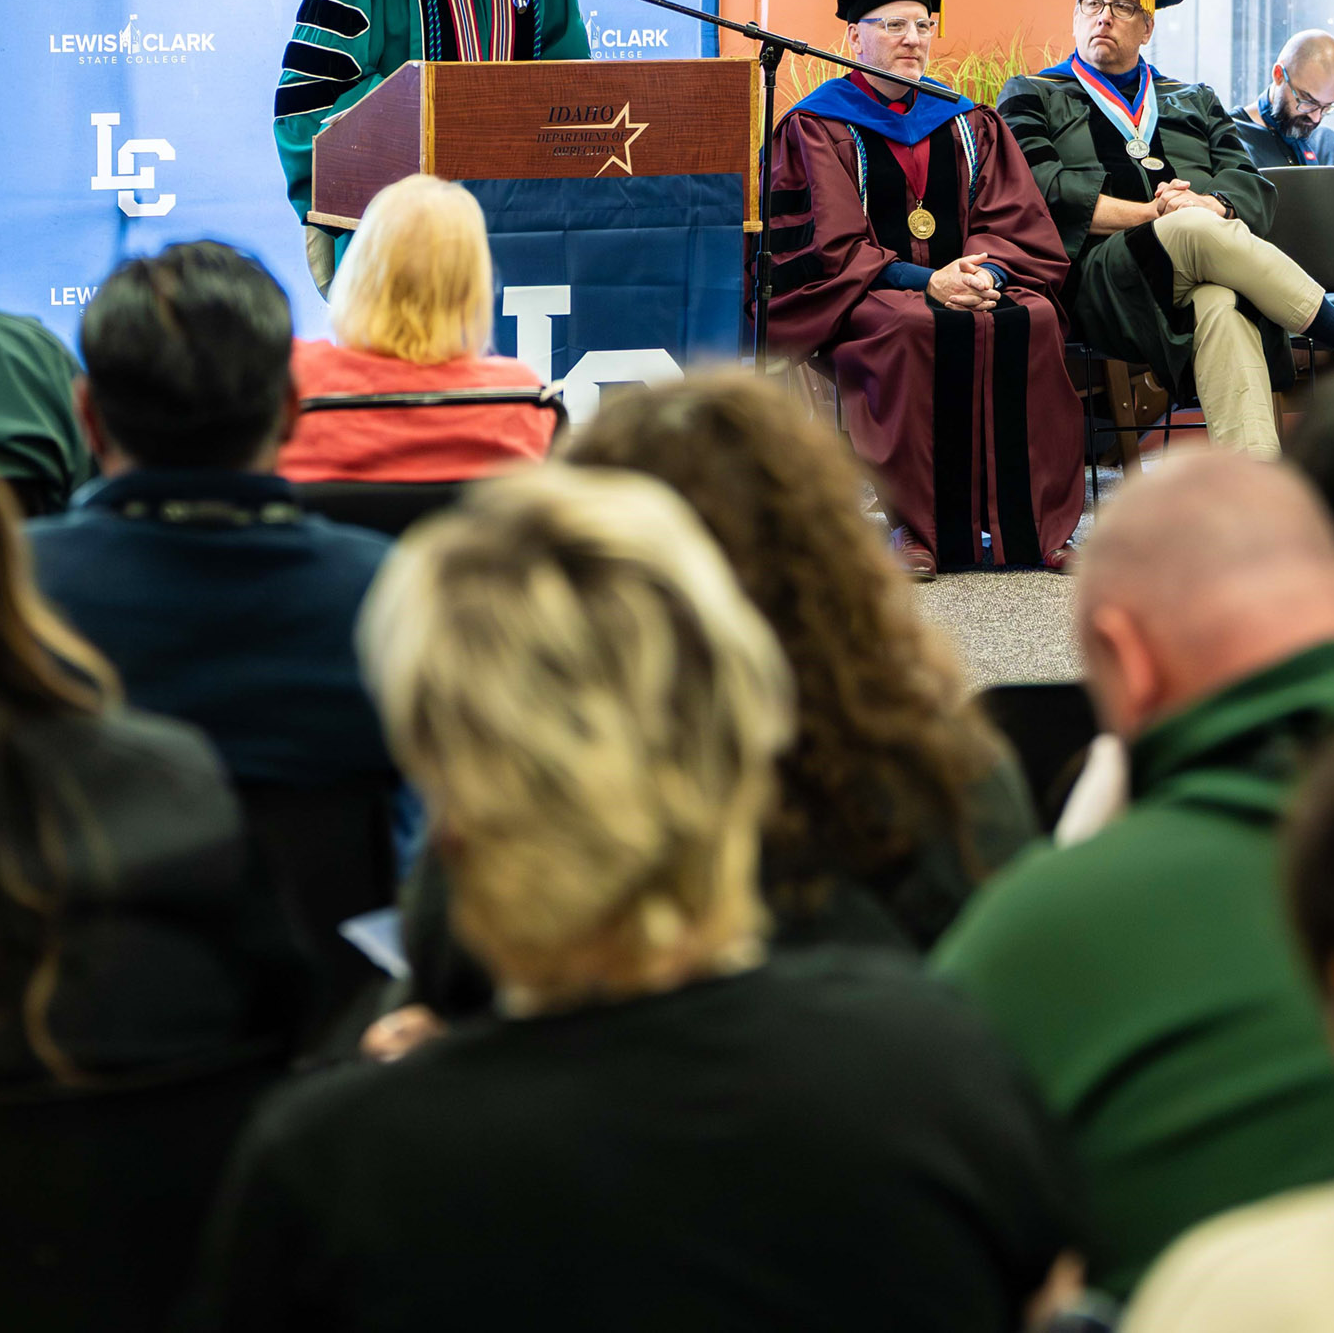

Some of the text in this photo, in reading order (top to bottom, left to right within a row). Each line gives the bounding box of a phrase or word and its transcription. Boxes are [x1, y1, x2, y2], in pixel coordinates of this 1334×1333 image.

[49, 33, 216, 53] LEWIS CLARK
[601, 28, 669, 48] CLARK
[78, 54, 187, 65] STATE COLLEGE
[593, 50, 647, 59] OLLEGE
[547, 106, 614, 123] IDAHO
[537, 131, 627, 143] DEPARTMENT OF
[91, 113, 176, 216] LC
[51, 286, 98, 306] LEW
